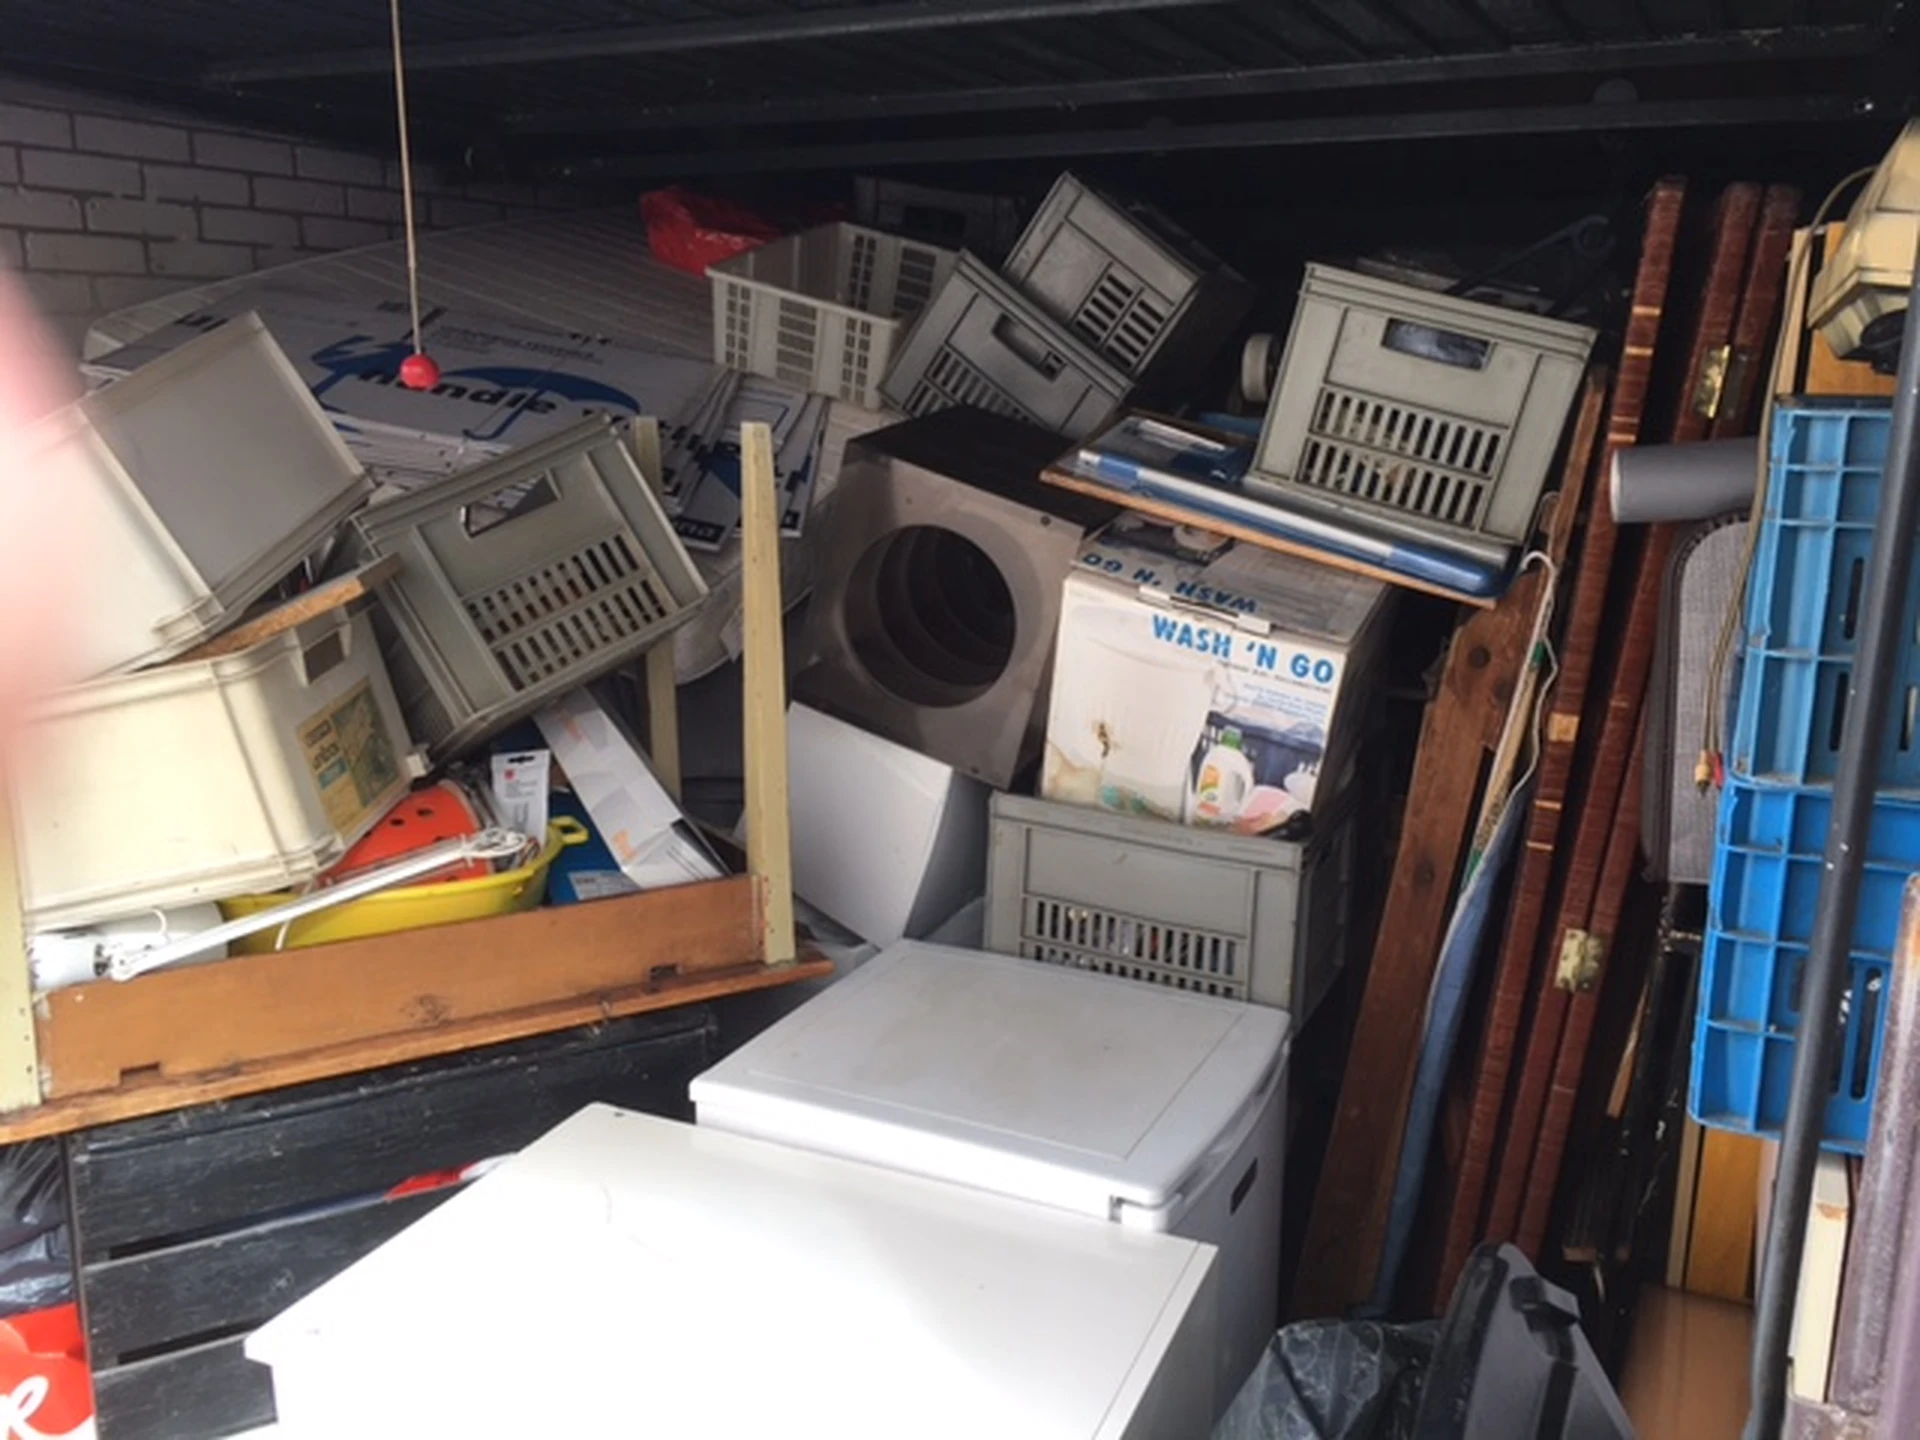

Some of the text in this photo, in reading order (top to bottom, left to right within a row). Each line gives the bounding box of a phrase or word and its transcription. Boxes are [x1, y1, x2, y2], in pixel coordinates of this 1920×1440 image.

[1083, 553, 1123, 573] GO
[1175, 582, 1258, 613] WASH
[1153, 614, 1232, 658] WASH
[1290, 654, 1335, 683] GO
